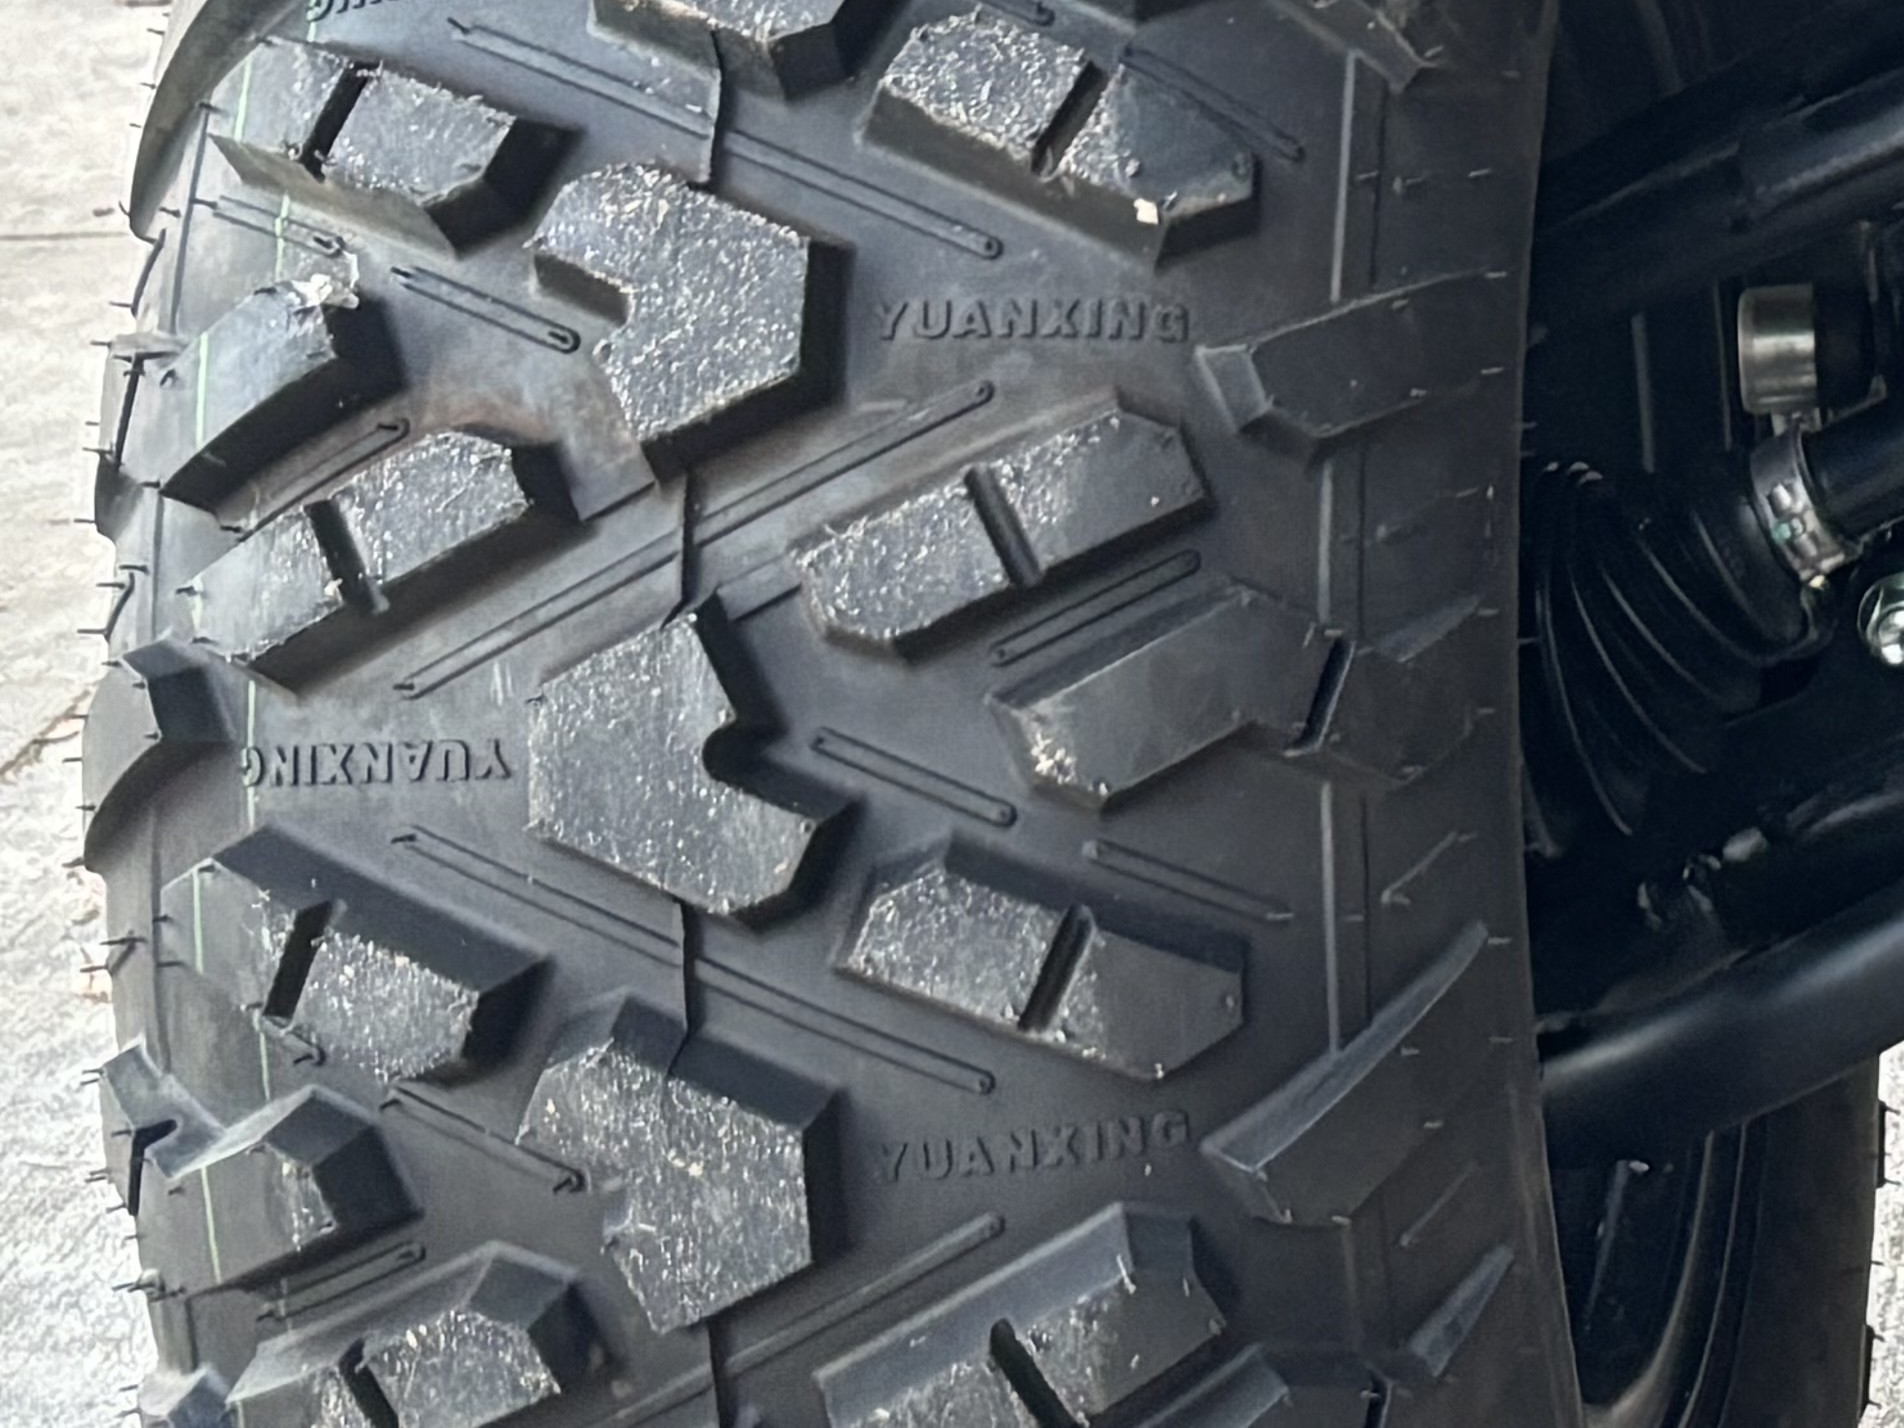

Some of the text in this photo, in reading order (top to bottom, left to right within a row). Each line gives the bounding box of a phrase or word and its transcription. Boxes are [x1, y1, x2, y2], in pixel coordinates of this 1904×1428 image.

[876, 295, 1190, 344] YUANXING
[241, 737, 512, 787] YUANXING
[877, 1110, 1195, 1183] YUANXING
